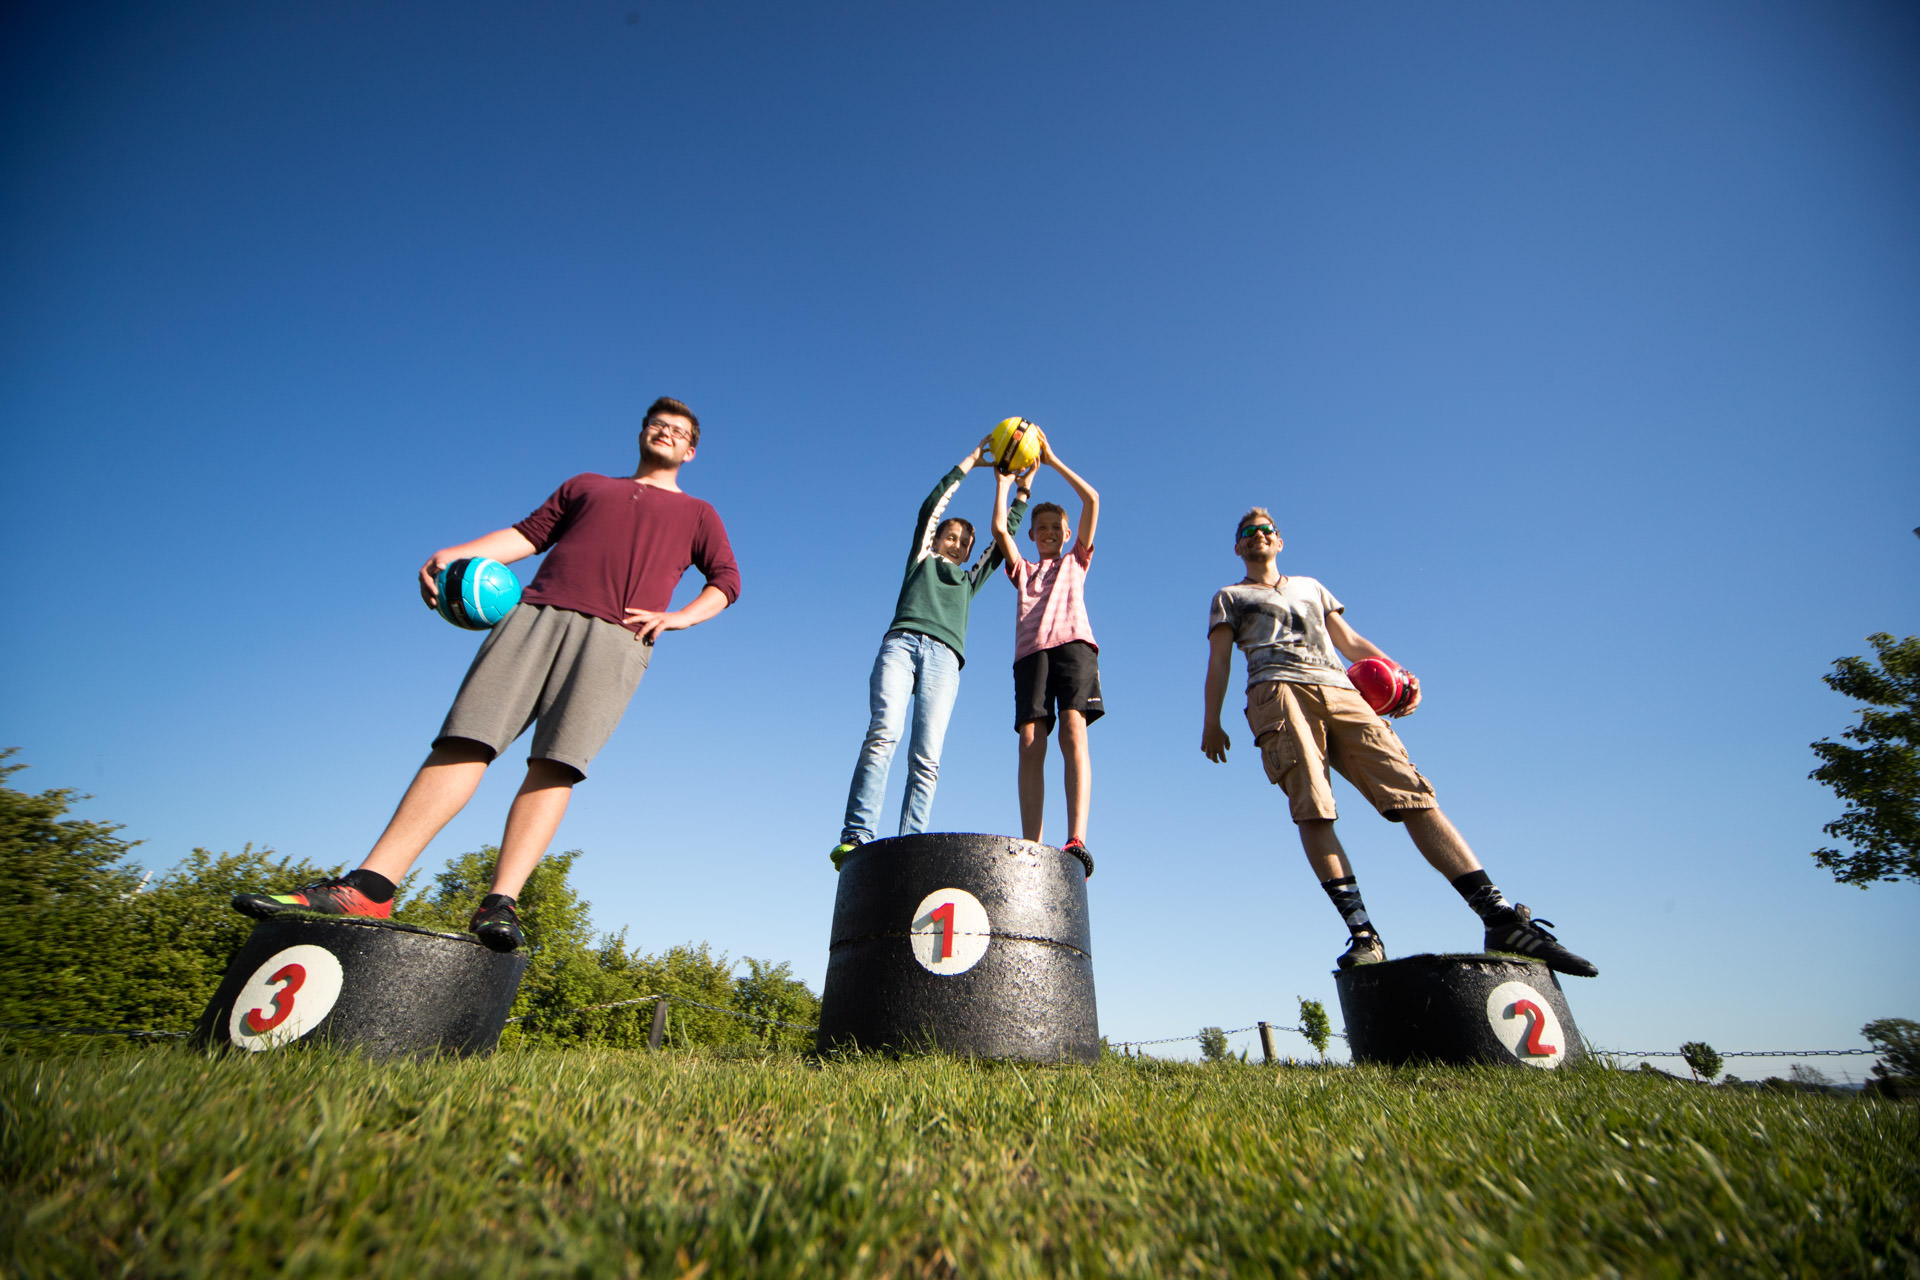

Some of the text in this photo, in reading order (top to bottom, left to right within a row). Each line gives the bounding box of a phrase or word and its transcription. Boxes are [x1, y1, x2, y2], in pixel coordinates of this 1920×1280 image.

[930, 902, 955, 958] 1
[247, 962, 307, 1032] 3
[1514, 999, 1556, 1054] 2
